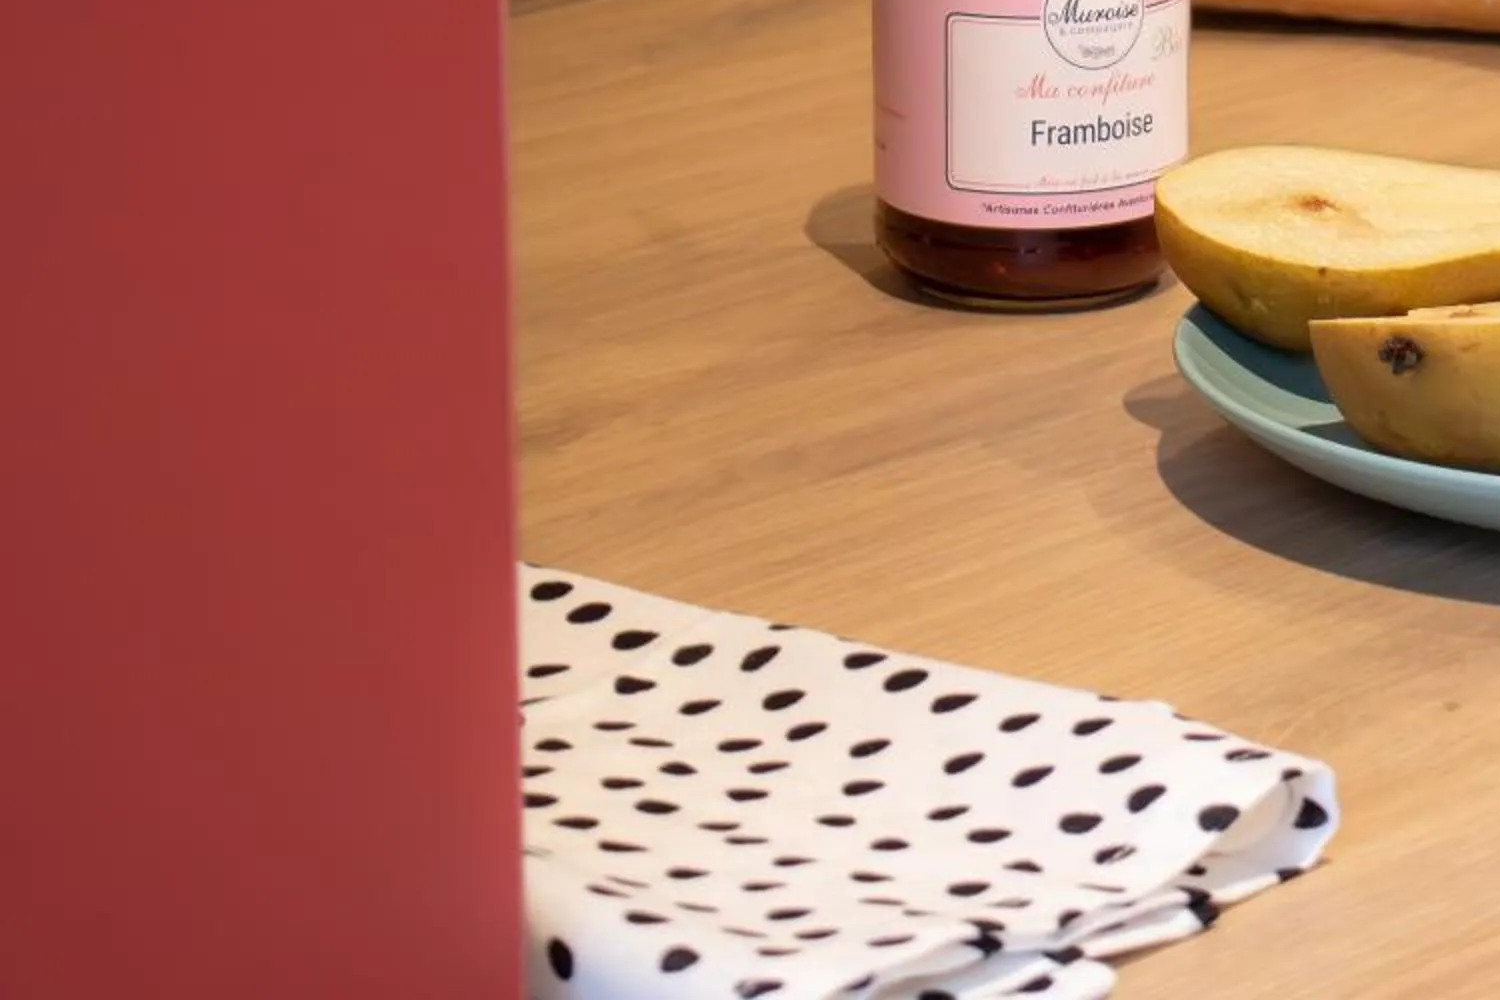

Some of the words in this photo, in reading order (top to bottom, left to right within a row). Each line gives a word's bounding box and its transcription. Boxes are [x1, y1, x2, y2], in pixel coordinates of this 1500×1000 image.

[1016, 73, 1060, 99] Ma
[1067, 70, 1155, 106] confiture
[1031, 111, 1153, 146] Framboise
